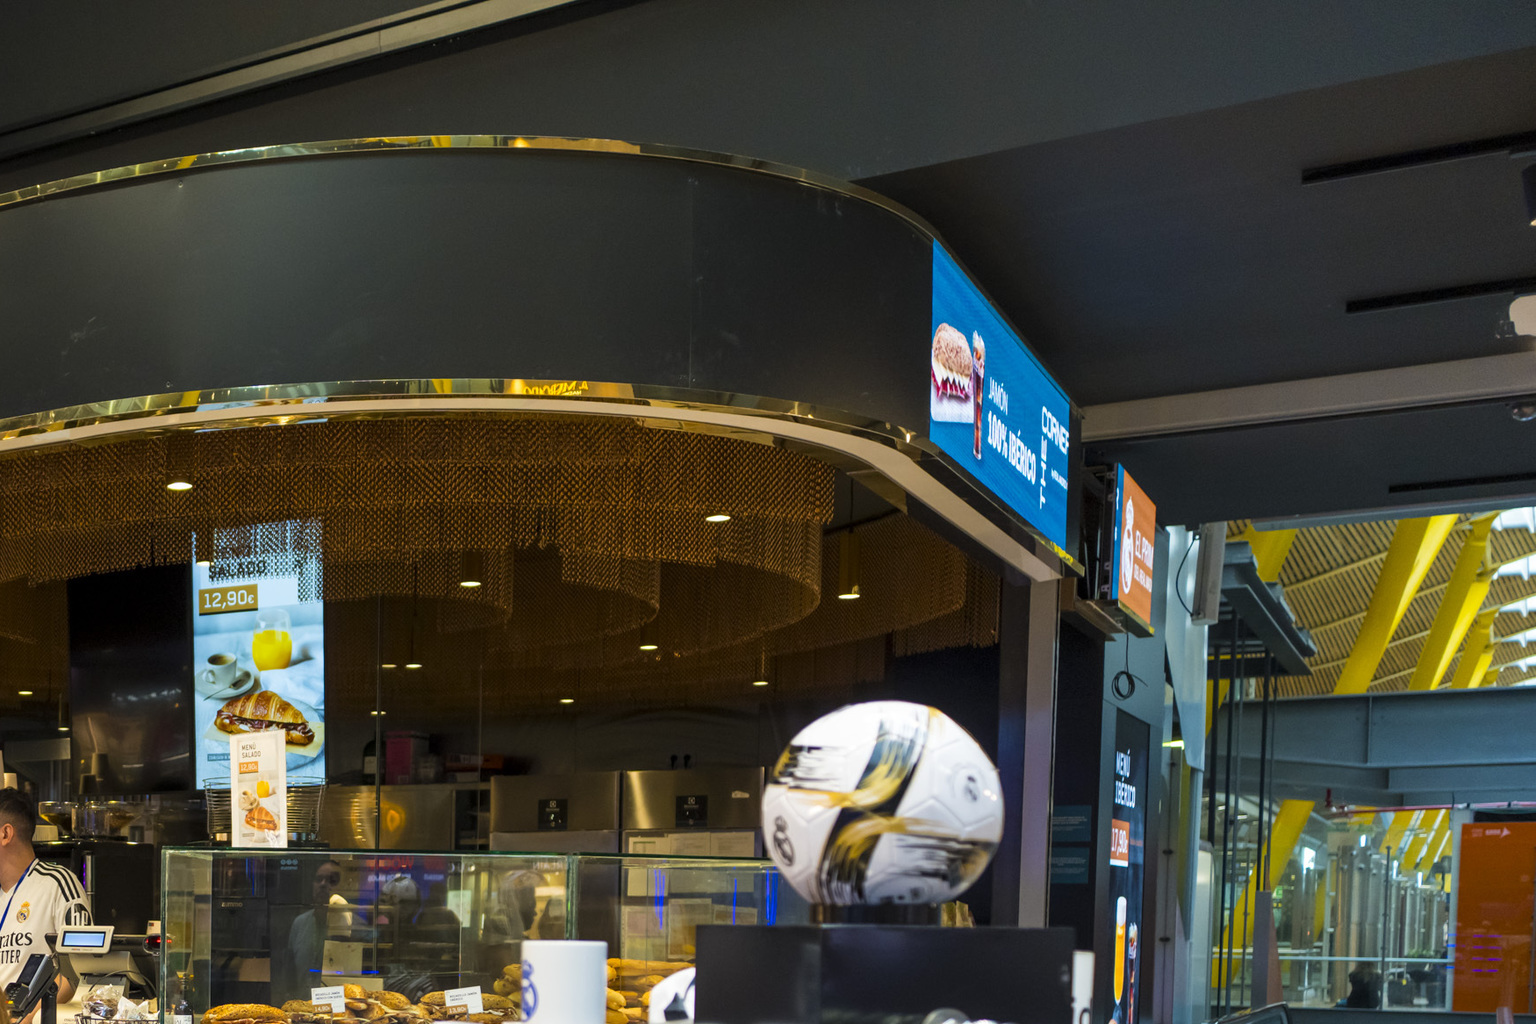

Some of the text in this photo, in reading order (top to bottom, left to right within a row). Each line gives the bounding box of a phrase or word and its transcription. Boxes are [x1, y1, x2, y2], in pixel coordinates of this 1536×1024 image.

[989, 376, 1009, 416] JAMÓN
[987, 410, 1008, 459] 100%
[1009, 430, 1037, 485] IBÉRICO
[204, 590, 255, 609] 12,90€
[1116, 748, 1131, 778] MENÚ
[1114, 776, 1136, 808] IBÉRICO
[71, 903, 89, 926] hp
